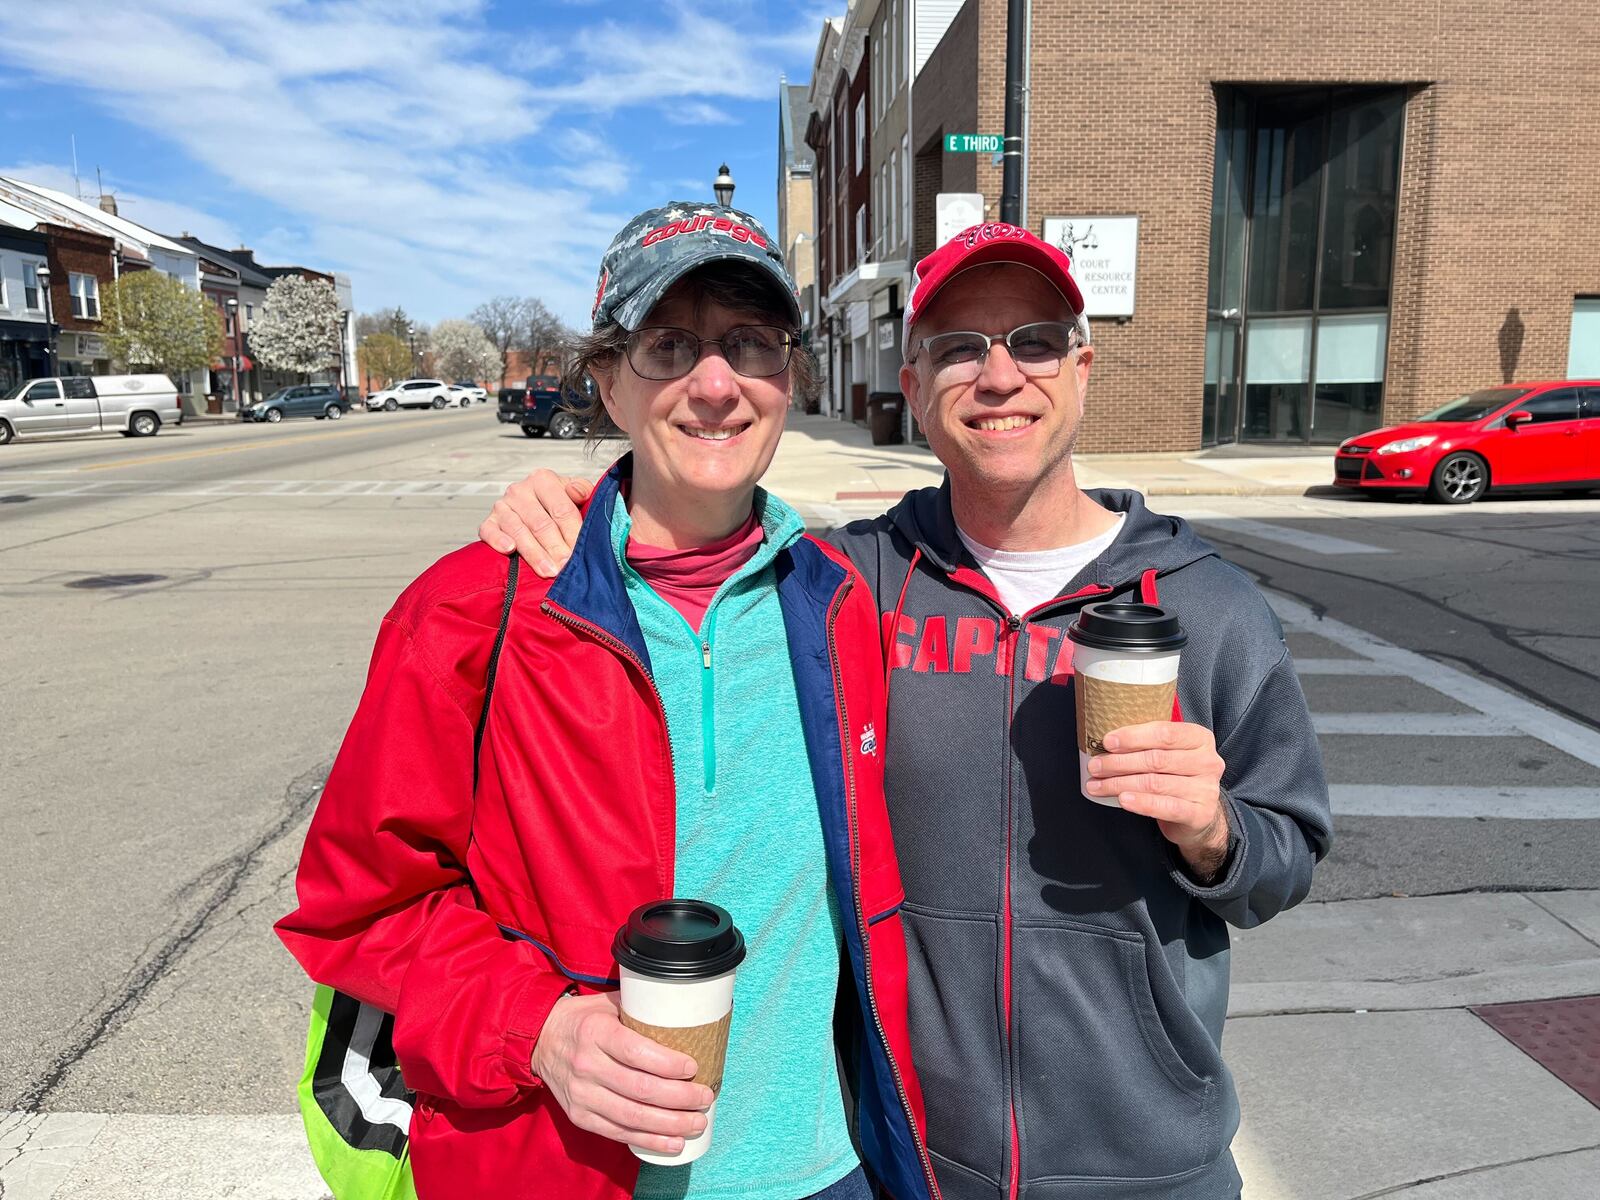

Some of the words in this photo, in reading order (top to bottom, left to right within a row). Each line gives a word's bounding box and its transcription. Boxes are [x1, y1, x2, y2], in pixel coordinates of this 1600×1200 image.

[949, 135, 958, 151] E
[962, 135, 999, 151] THIRD
[641, 214, 768, 249] courage
[1080, 259, 1111, 269] COURT
[1085, 272, 1133, 281] RESOURCE
[1091, 285, 1128, 295] CENTER
